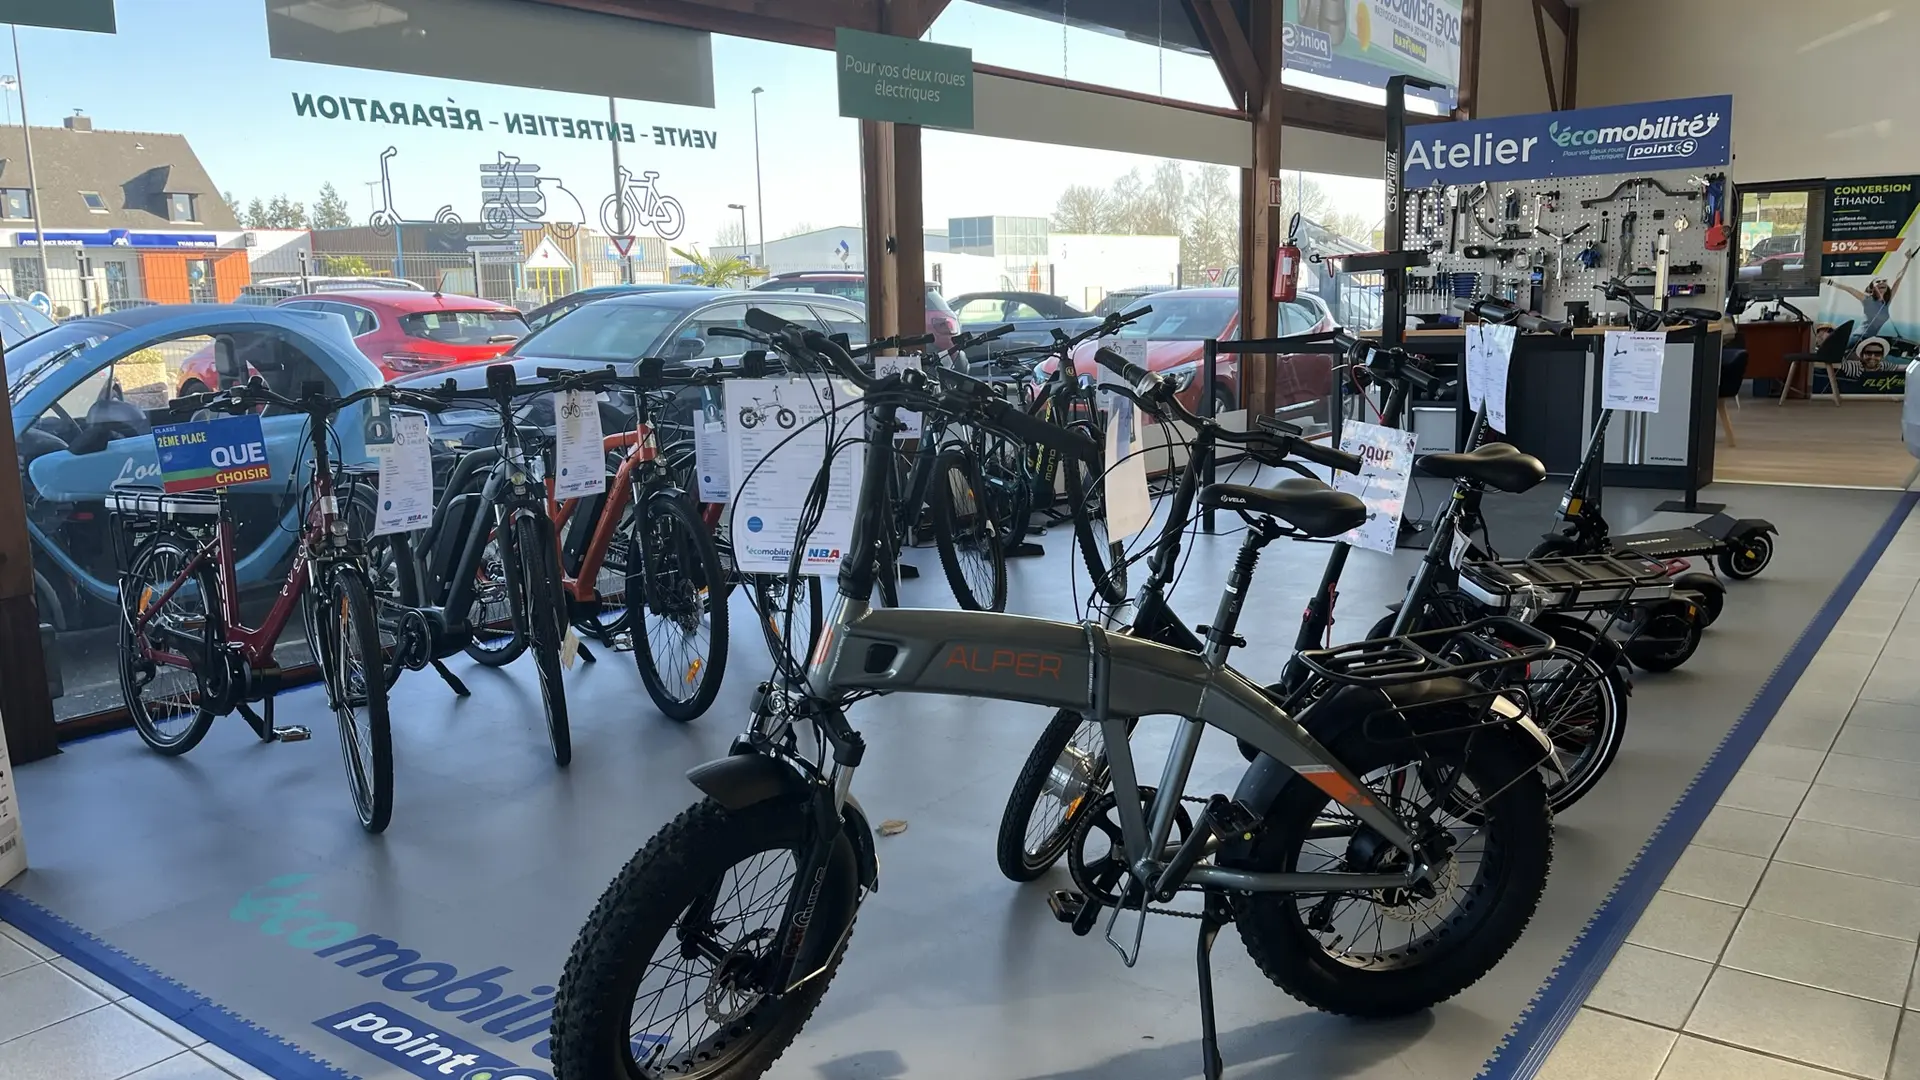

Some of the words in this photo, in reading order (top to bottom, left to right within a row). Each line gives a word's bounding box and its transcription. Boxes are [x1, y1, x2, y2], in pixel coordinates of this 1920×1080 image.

[844, 54, 876, 75] Pour
[878, 64, 899, 78] vos
[901, 64, 932, 83] deux
[934, 71, 966, 87] roues
[874, 79, 940, 102] électriques
[1557, 113, 1706, 147] écomobilité
[1404, 132, 1538, 172] Atelier
[1633, 143, 1674, 157] point
[1682, 141, 1694, 153] S
[1834, 183, 1912, 196] CONVERSION
[1833, 195, 1886, 206] ÉTHANOL
[1830, 241, 1858, 252] 50%
[154, 426, 176, 434] CLASSÉ
[182, 431, 207, 445] PLACE
[210, 441, 266, 468] QUE
[216, 467, 268, 484] CHOISIR
[945, 644, 1063, 681] ALPER
[332, 1010, 480, 1075] point
